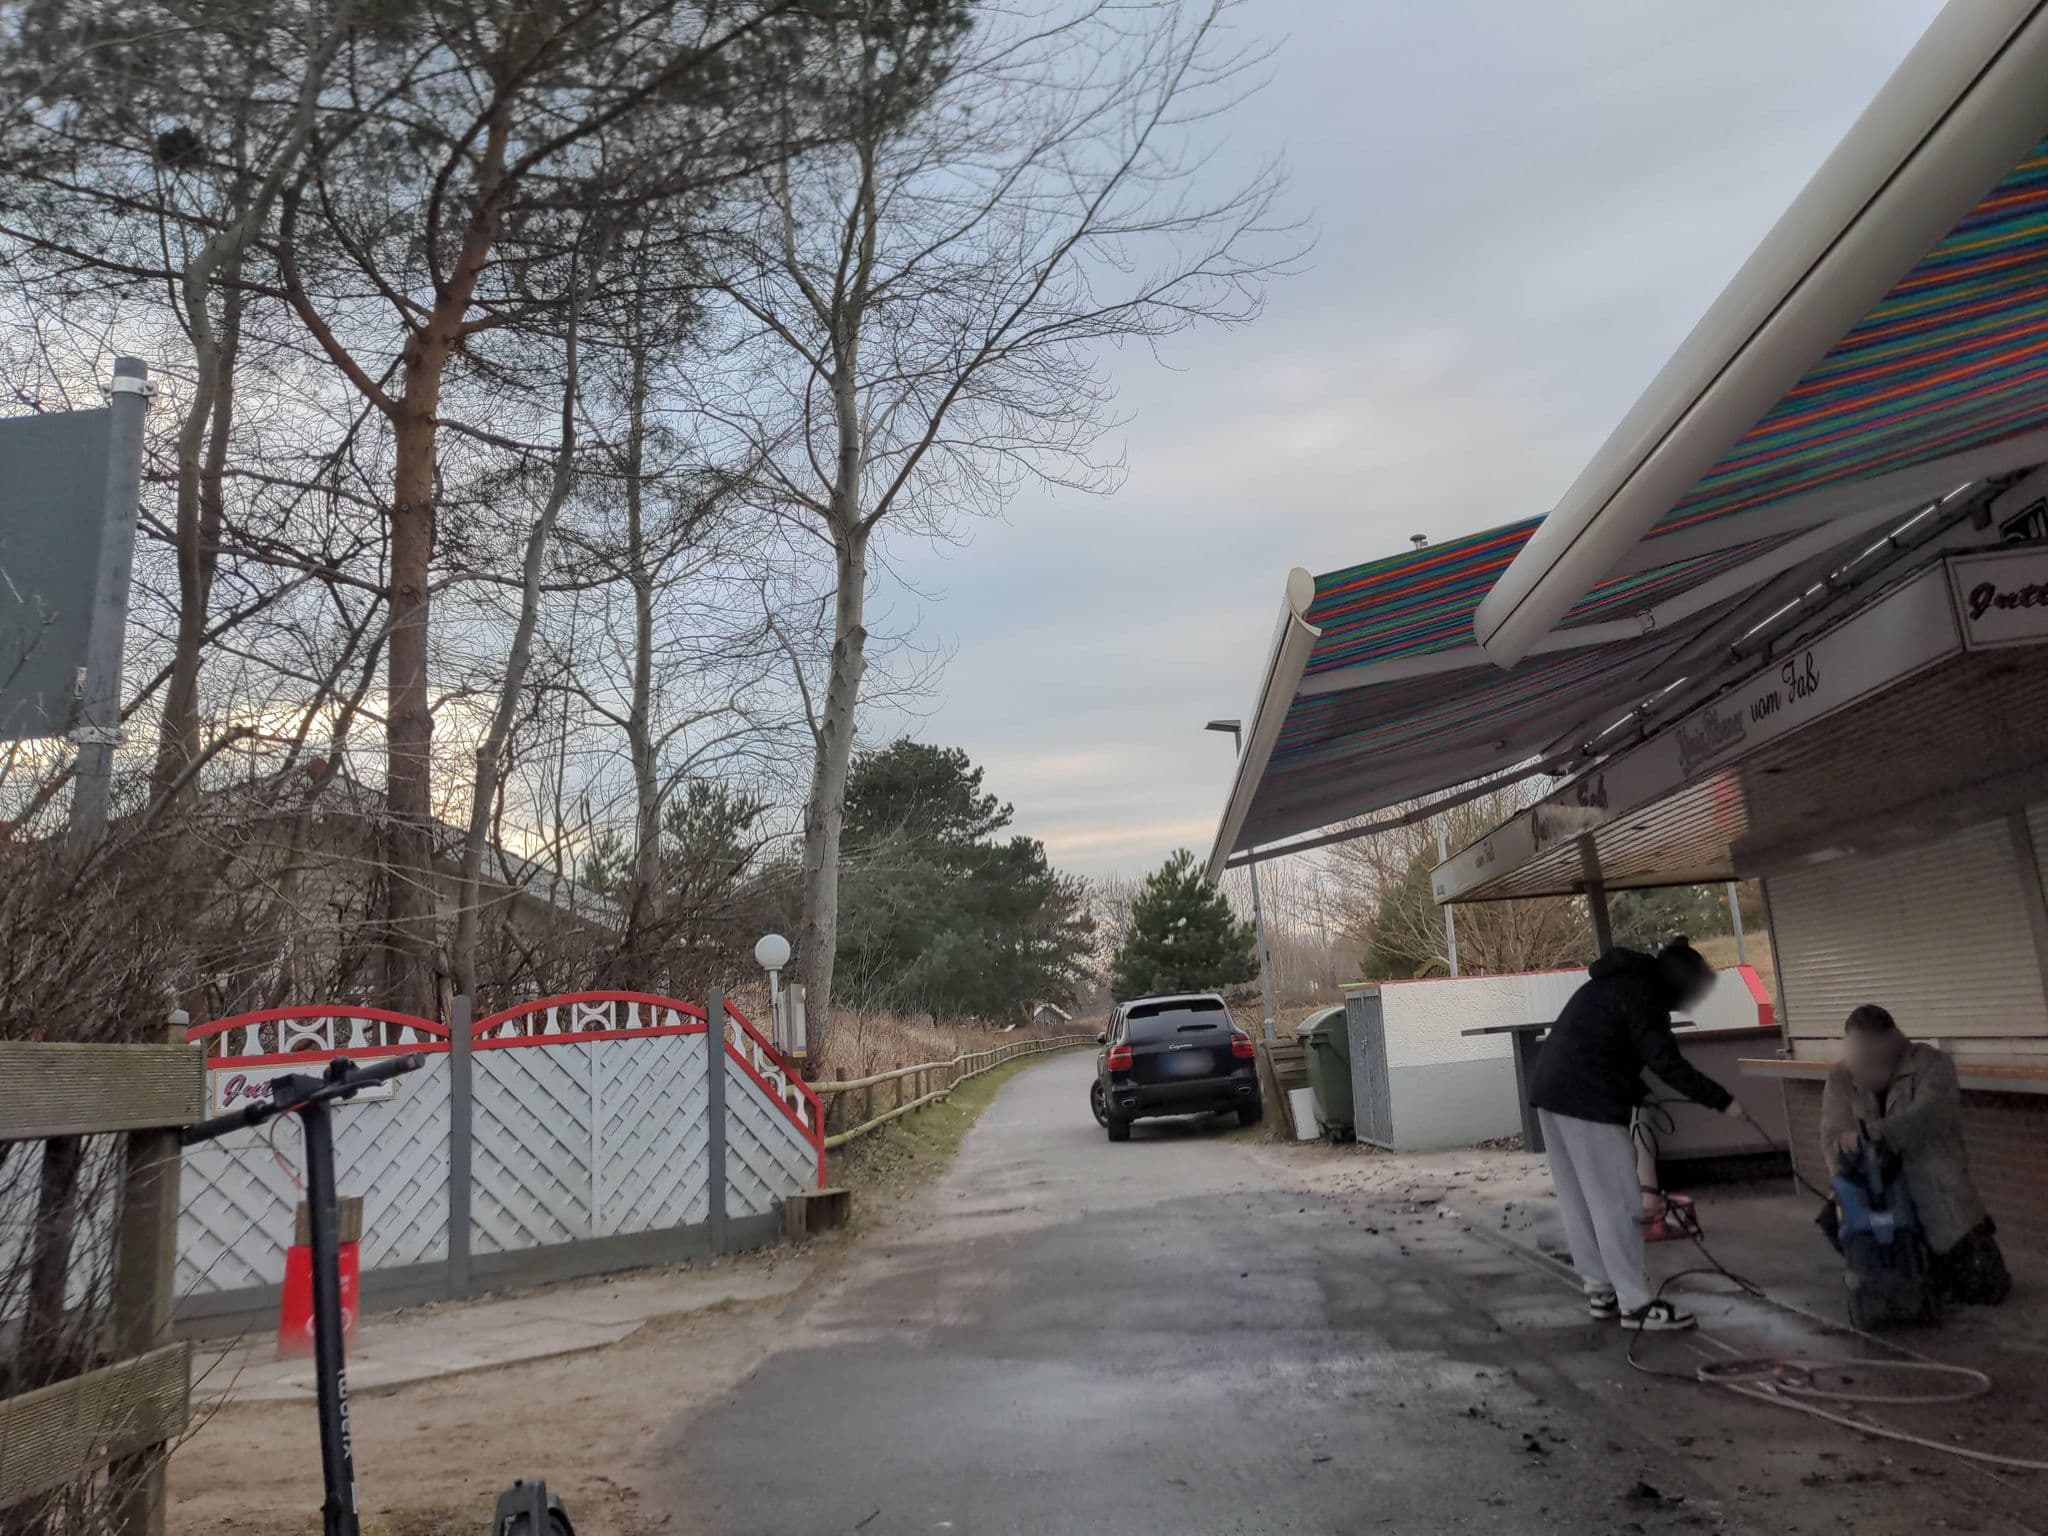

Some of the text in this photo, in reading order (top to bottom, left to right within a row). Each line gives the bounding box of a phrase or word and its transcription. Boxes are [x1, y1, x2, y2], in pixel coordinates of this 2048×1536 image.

[1750, 651, 1820, 723] vom Faß
[222, 1073, 274, 1107] Jut
